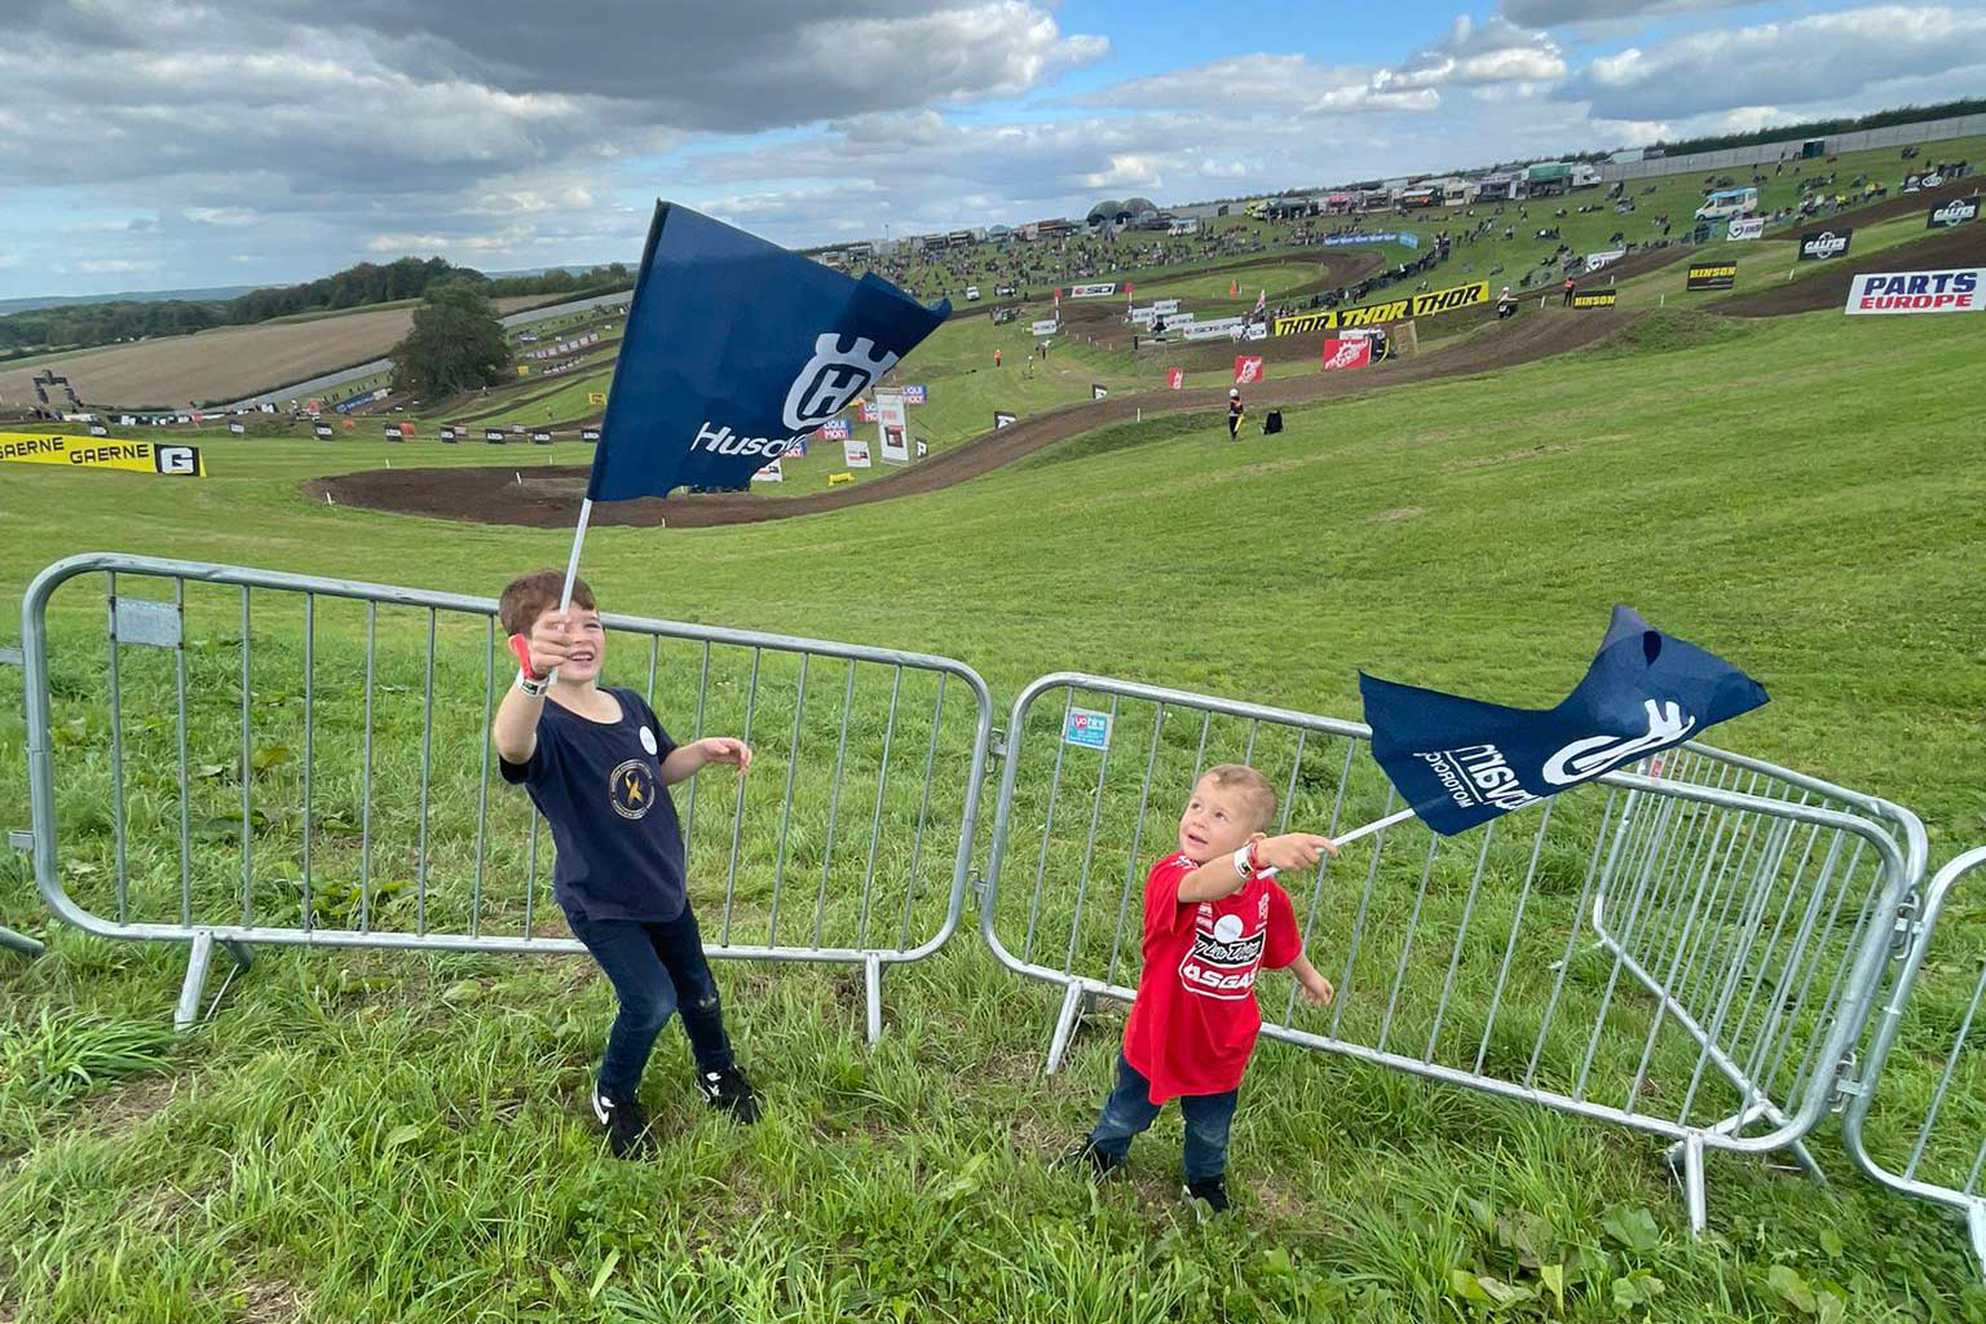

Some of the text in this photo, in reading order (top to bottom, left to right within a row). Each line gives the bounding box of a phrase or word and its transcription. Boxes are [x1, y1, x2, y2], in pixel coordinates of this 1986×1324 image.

[1863, 273, 1978, 296] PARTS
[1342, 300, 1408, 327] THOR
[1417, 284, 1482, 314] THOR
[1859, 294, 1974, 310] EUROPE
[0, 437, 149, 464] AERNE GAERNE
[161, 447, 194, 474] G
